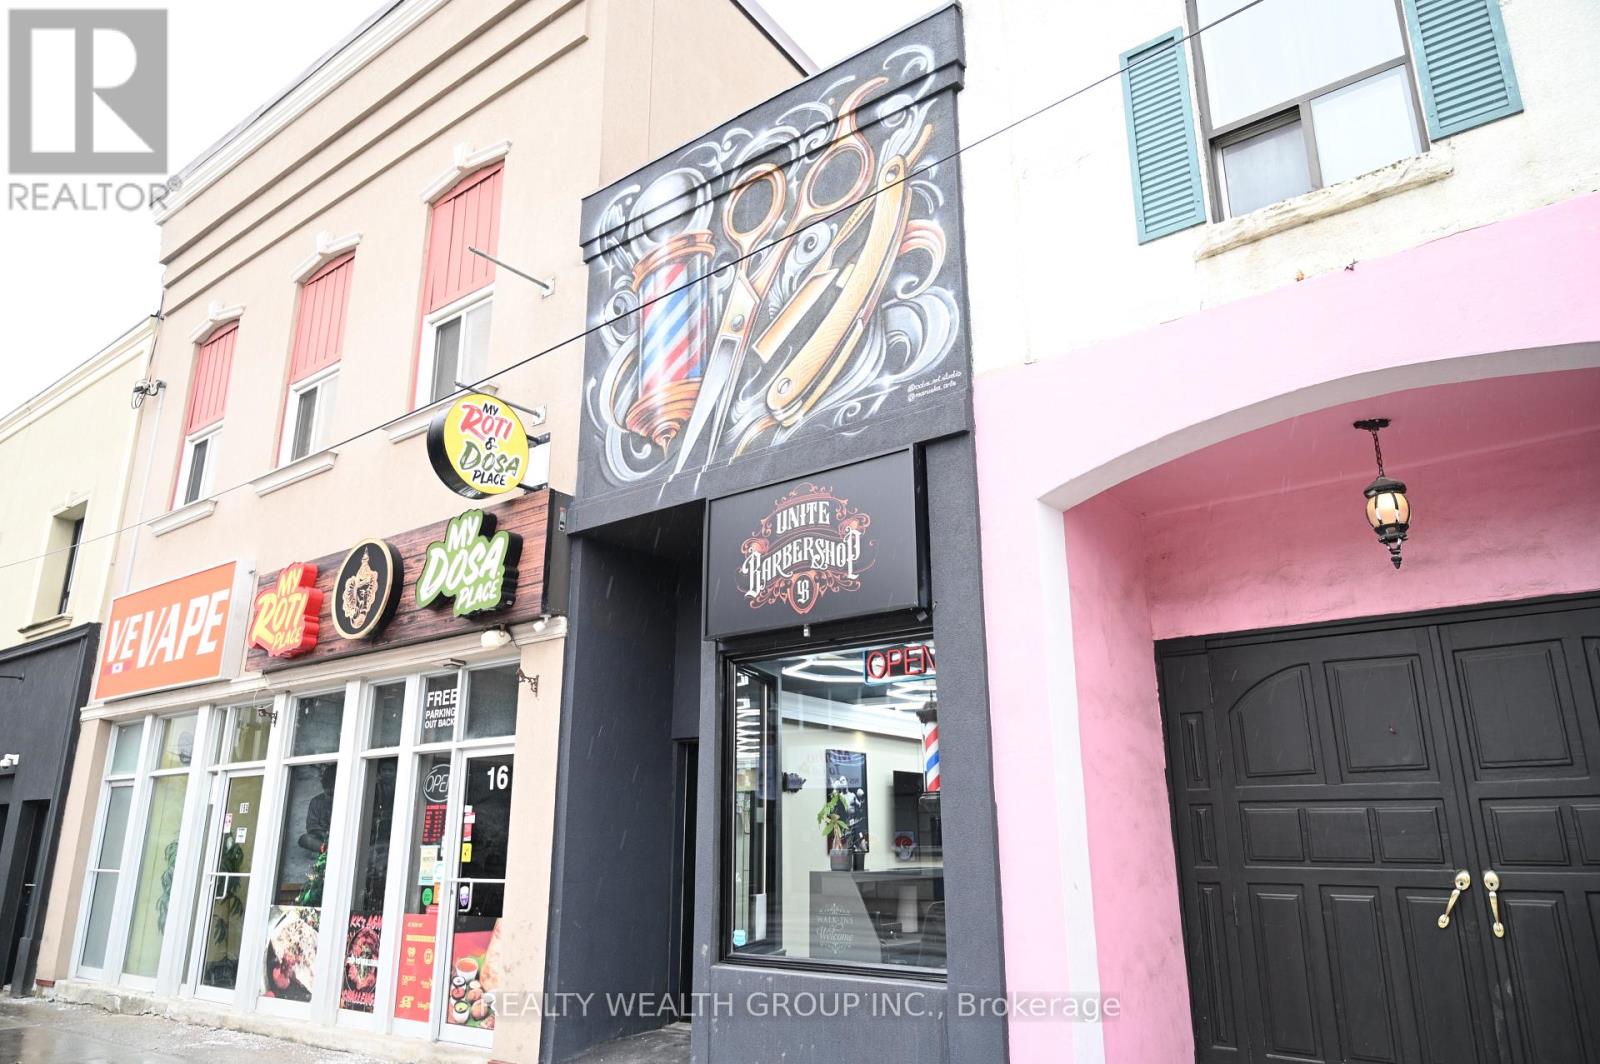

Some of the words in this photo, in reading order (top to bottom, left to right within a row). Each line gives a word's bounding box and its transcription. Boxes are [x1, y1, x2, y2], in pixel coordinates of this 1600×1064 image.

[461, 404, 513, 441] ROTI
[482, 402, 499, 416] MY
[485, 437, 498, 450] &
[460, 441, 520, 477] DOSA
[472, 470, 506, 486] PLACE
[776, 501, 830, 534] UNITE
[448, 516, 480, 552] MY
[278, 567, 302, 598] MY
[420, 537, 505, 602] DOSA
[457, 578, 500, 610] PLACE
[252, 592, 307, 646] ROTI
[272, 626, 302, 650] PLACE
[426, 688, 457, 707] FREE
[424, 719, 437, 729] OUT
[425, 707, 456, 719] PARKING
[487, 765, 508, 790] 16
